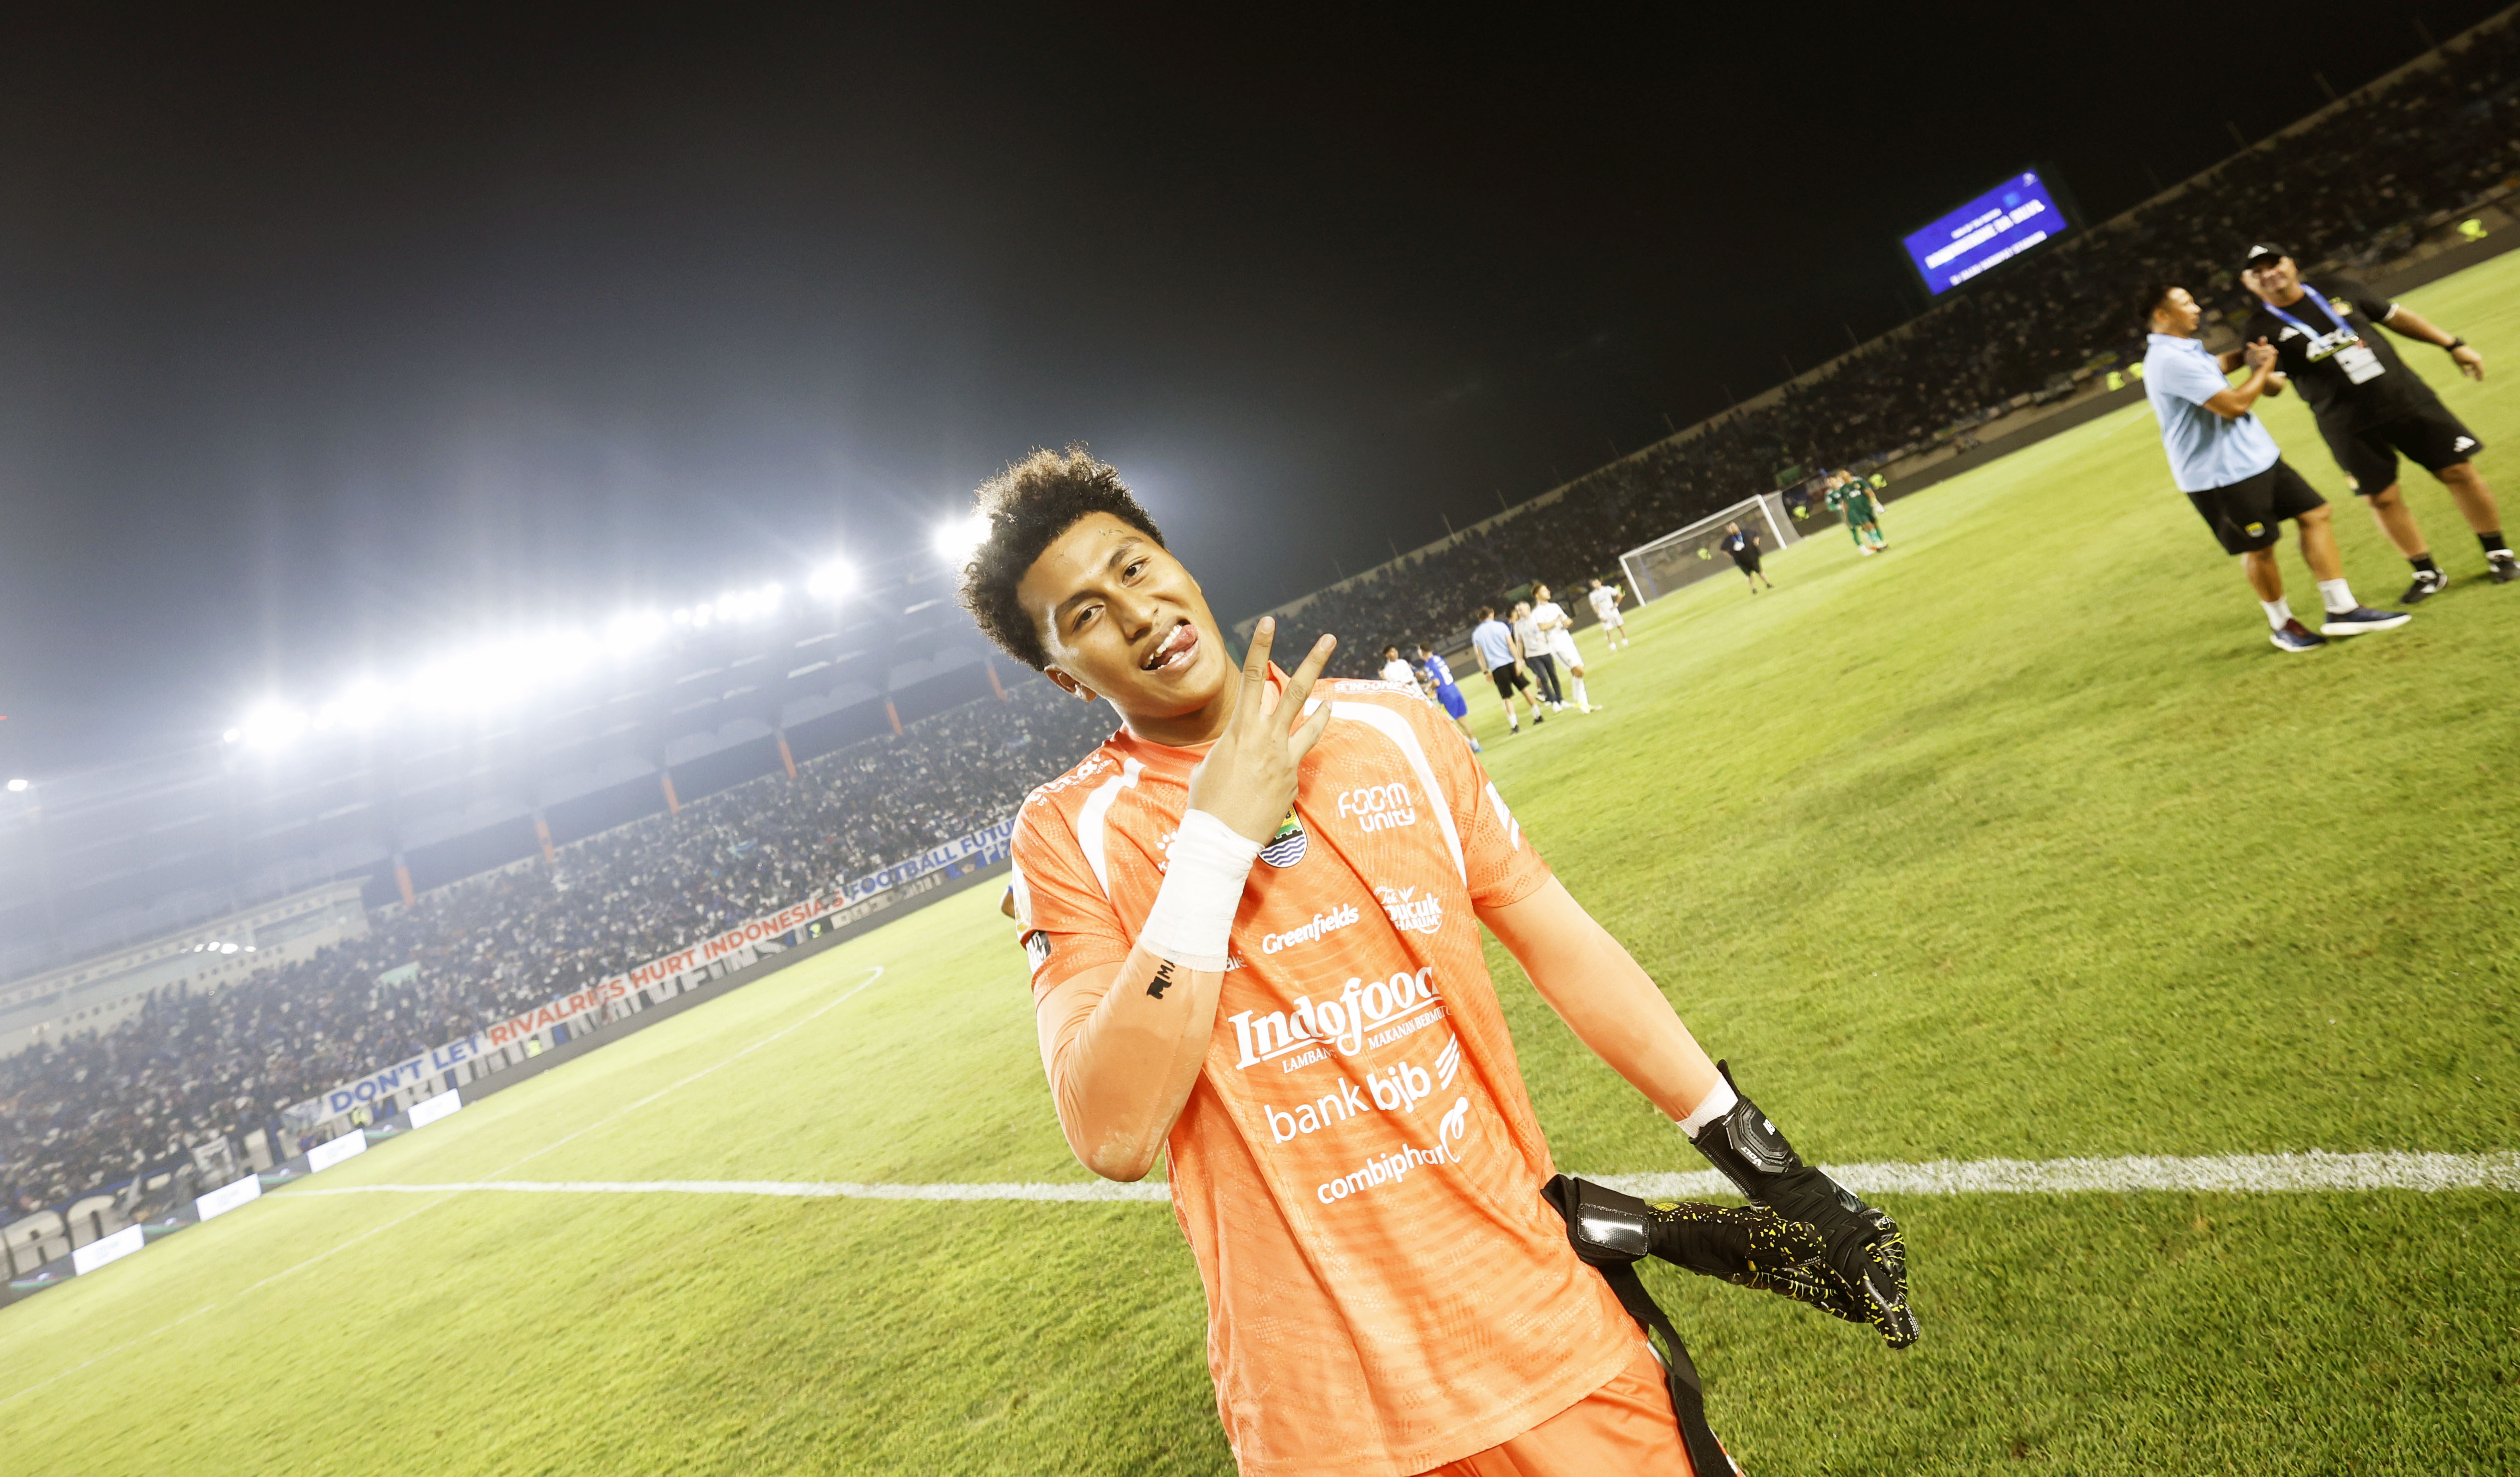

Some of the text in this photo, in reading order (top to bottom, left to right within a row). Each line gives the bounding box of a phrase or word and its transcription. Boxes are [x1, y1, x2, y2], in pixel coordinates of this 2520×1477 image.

[1262, 903, 1359, 954] Greenfields
[330, 1060, 423, 1112] DON'T
[433, 1033, 480, 1070] LET
[489, 980, 625, 1046] RIVALRIES
[630, 949, 696, 988] HURT
[849, 847, 958, 900] FOOTBALL
[1367, 1019, 1416, 1050] MAKANAN
[1264, 1061, 1431, 1144] bank bjb
[1317, 1143, 1445, 1204] combiphar
